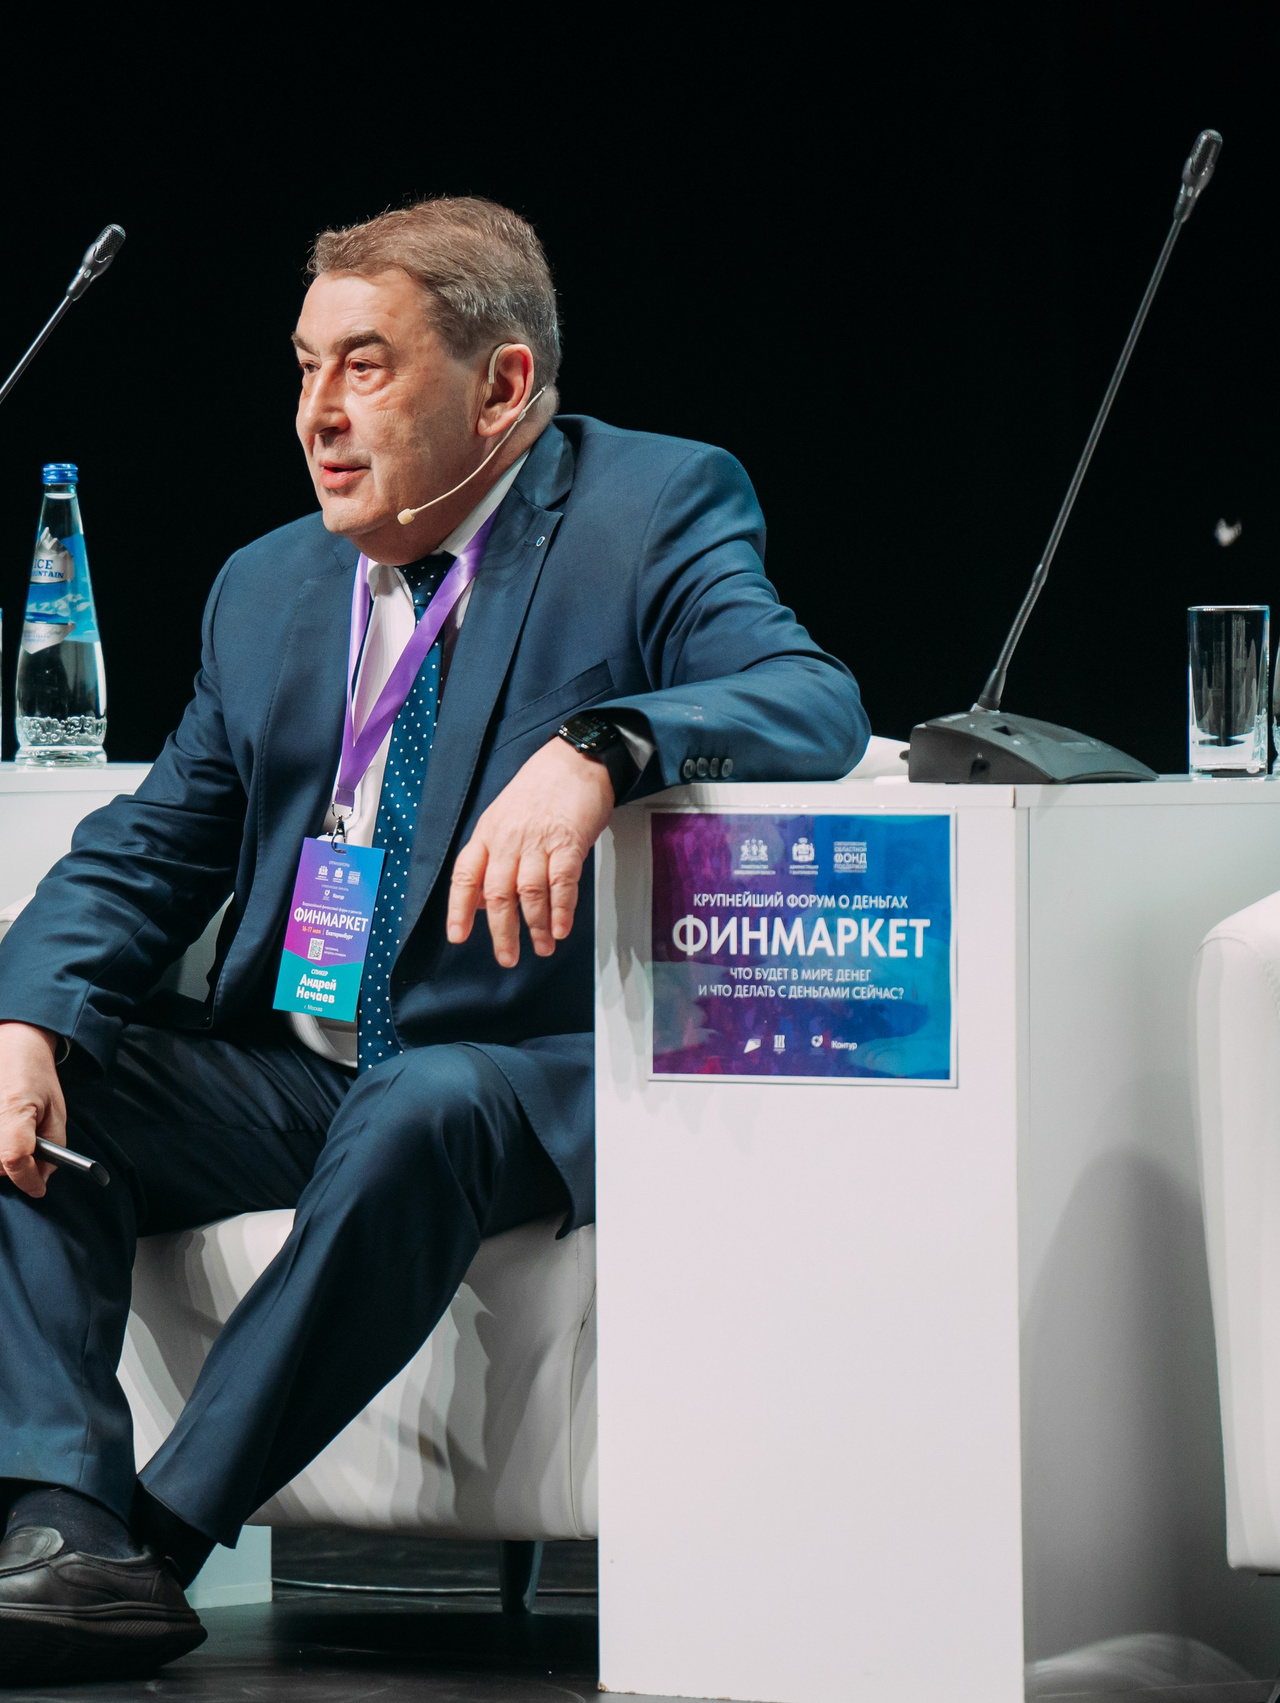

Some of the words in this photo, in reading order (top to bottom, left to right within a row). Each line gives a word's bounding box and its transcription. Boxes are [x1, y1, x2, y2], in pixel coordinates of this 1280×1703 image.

[34, 558, 54, 570] ICE
[834, 852, 867, 863] ФОНД
[693, 891, 784, 908] КРУПНЕЙШИЙ
[786, 894, 836, 908] ФОРУМ
[838, 894, 850, 909] О
[852, 895, 908, 910] ДЕНЬГАХ
[294, 907, 369, 933] ФИНМАРКЕТ
[673, 914, 931, 958] ФИНМАРКЕТ
[299, 973, 337, 992] Андрей
[730, 967, 753, 980] ЧТО
[755, 967, 790, 981] БУДЕТ
[792, 968, 799, 980] В
[801, 968, 834, 981] МИРЕ
[836, 969, 872, 983] ДЕНЕГ
[296, 985, 336, 1004] Нечаев
[698, 984, 708, 996] И
[709, 985, 732, 997] ЧТО
[734, 984, 776, 999] ДЕЛАТЬ
[777, 985, 787, 997] С
[789, 985, 850, 1000] ДЕНЬГАМИ
[852, 985, 904, 1000] СЕЙЧАС?
[830, 1040, 858, 1051] Контур
